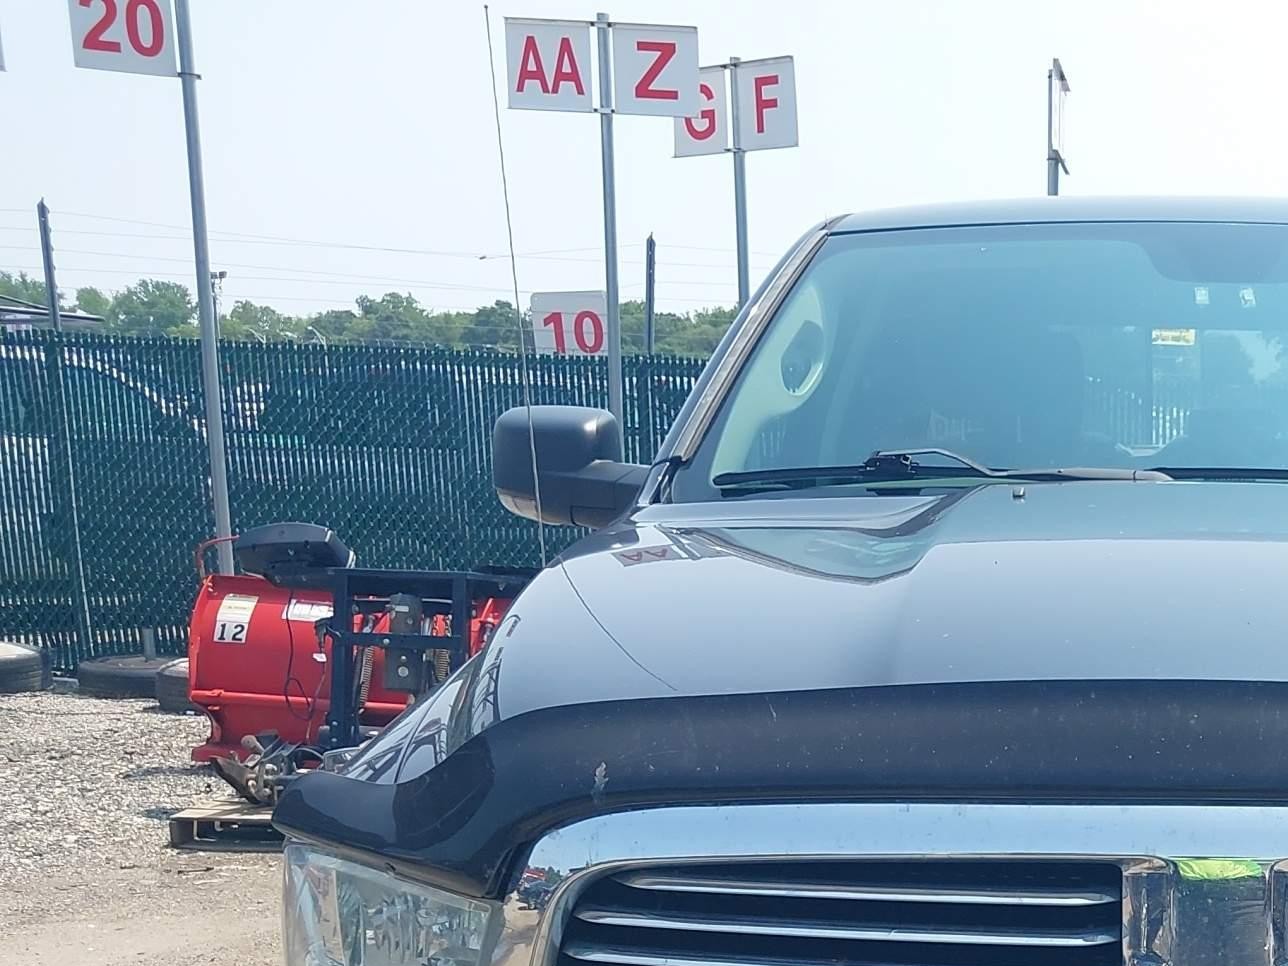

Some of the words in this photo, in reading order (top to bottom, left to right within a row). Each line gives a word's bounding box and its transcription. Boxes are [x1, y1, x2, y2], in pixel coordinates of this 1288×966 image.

[78, 0, 165, 58] 20
[516, 36, 584, 95] AA
[634, 41, 679, 101] Z
[684, 83, 716, 141] G
[754, 74, 779, 134] F
[543, 310, 604, 354] 10
[217, 623, 245, 642] 12
